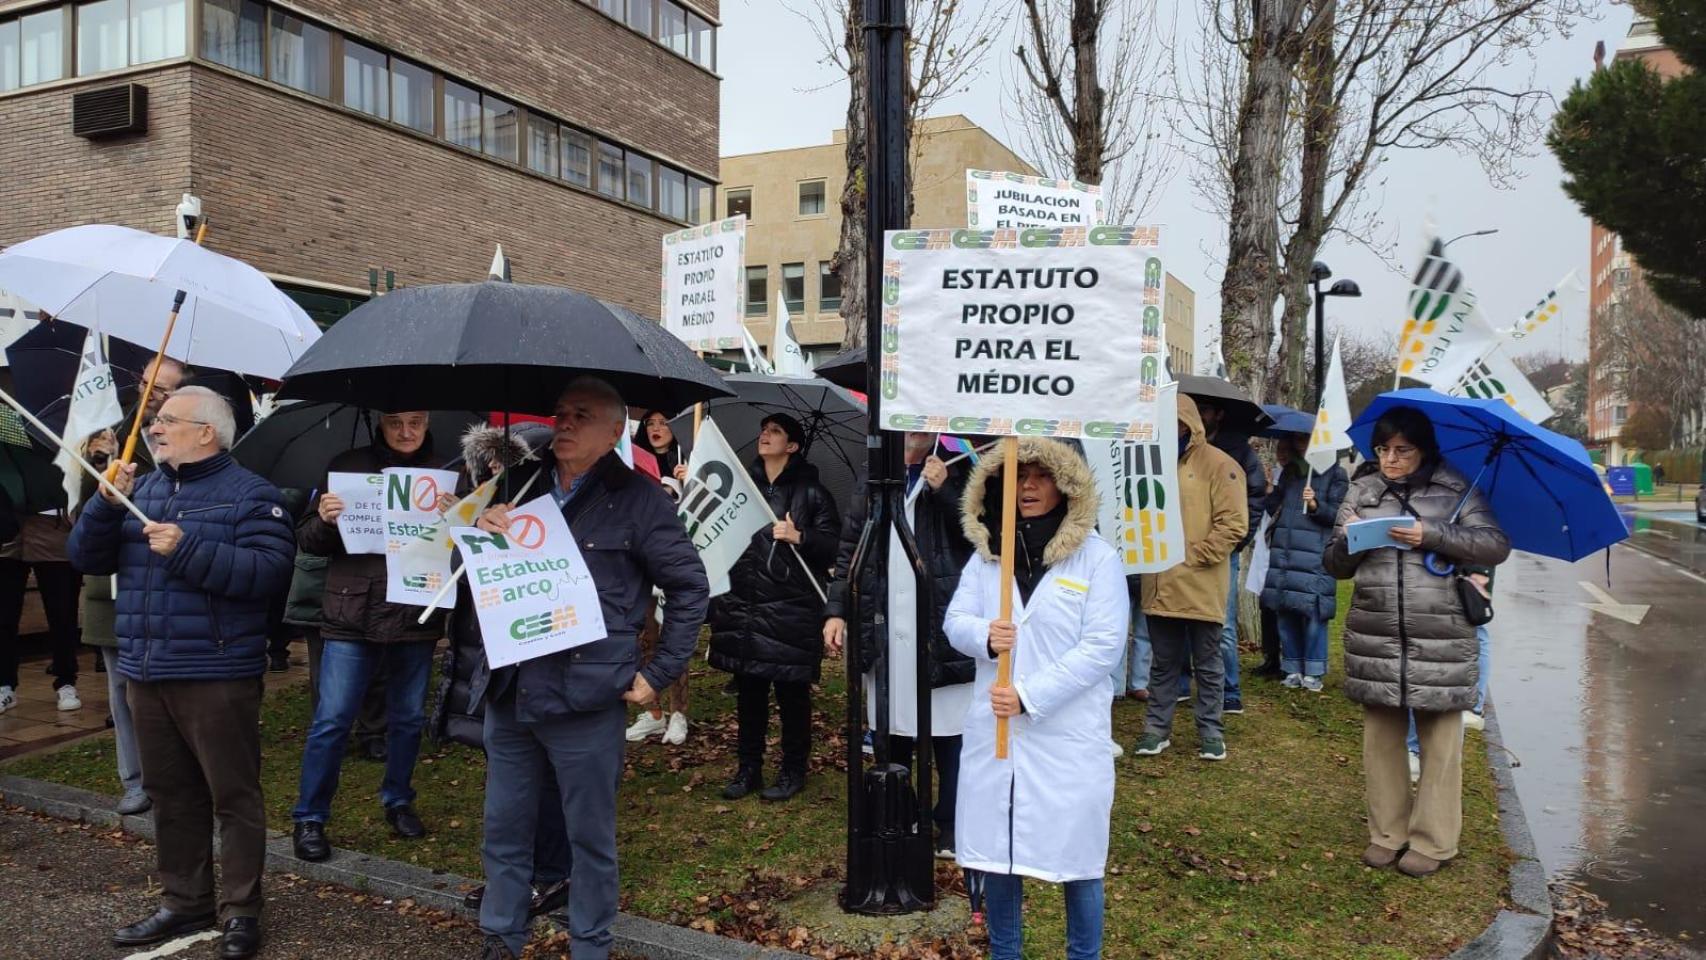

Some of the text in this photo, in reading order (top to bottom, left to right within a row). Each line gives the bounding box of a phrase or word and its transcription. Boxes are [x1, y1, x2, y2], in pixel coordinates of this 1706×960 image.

[994, 189, 1080, 208] JUBILACIÓN
[998, 204, 1058, 221] BASADA
[1061, 212, 1081, 223] EN
[942, 266, 1099, 290] ESTATUTO
[961, 304, 1075, 325] PROPIO
[955, 337, 1080, 361] PARA EL
[957, 368, 1074, 396] MÉDICO
[476, 557, 570, 585] Estatuto
